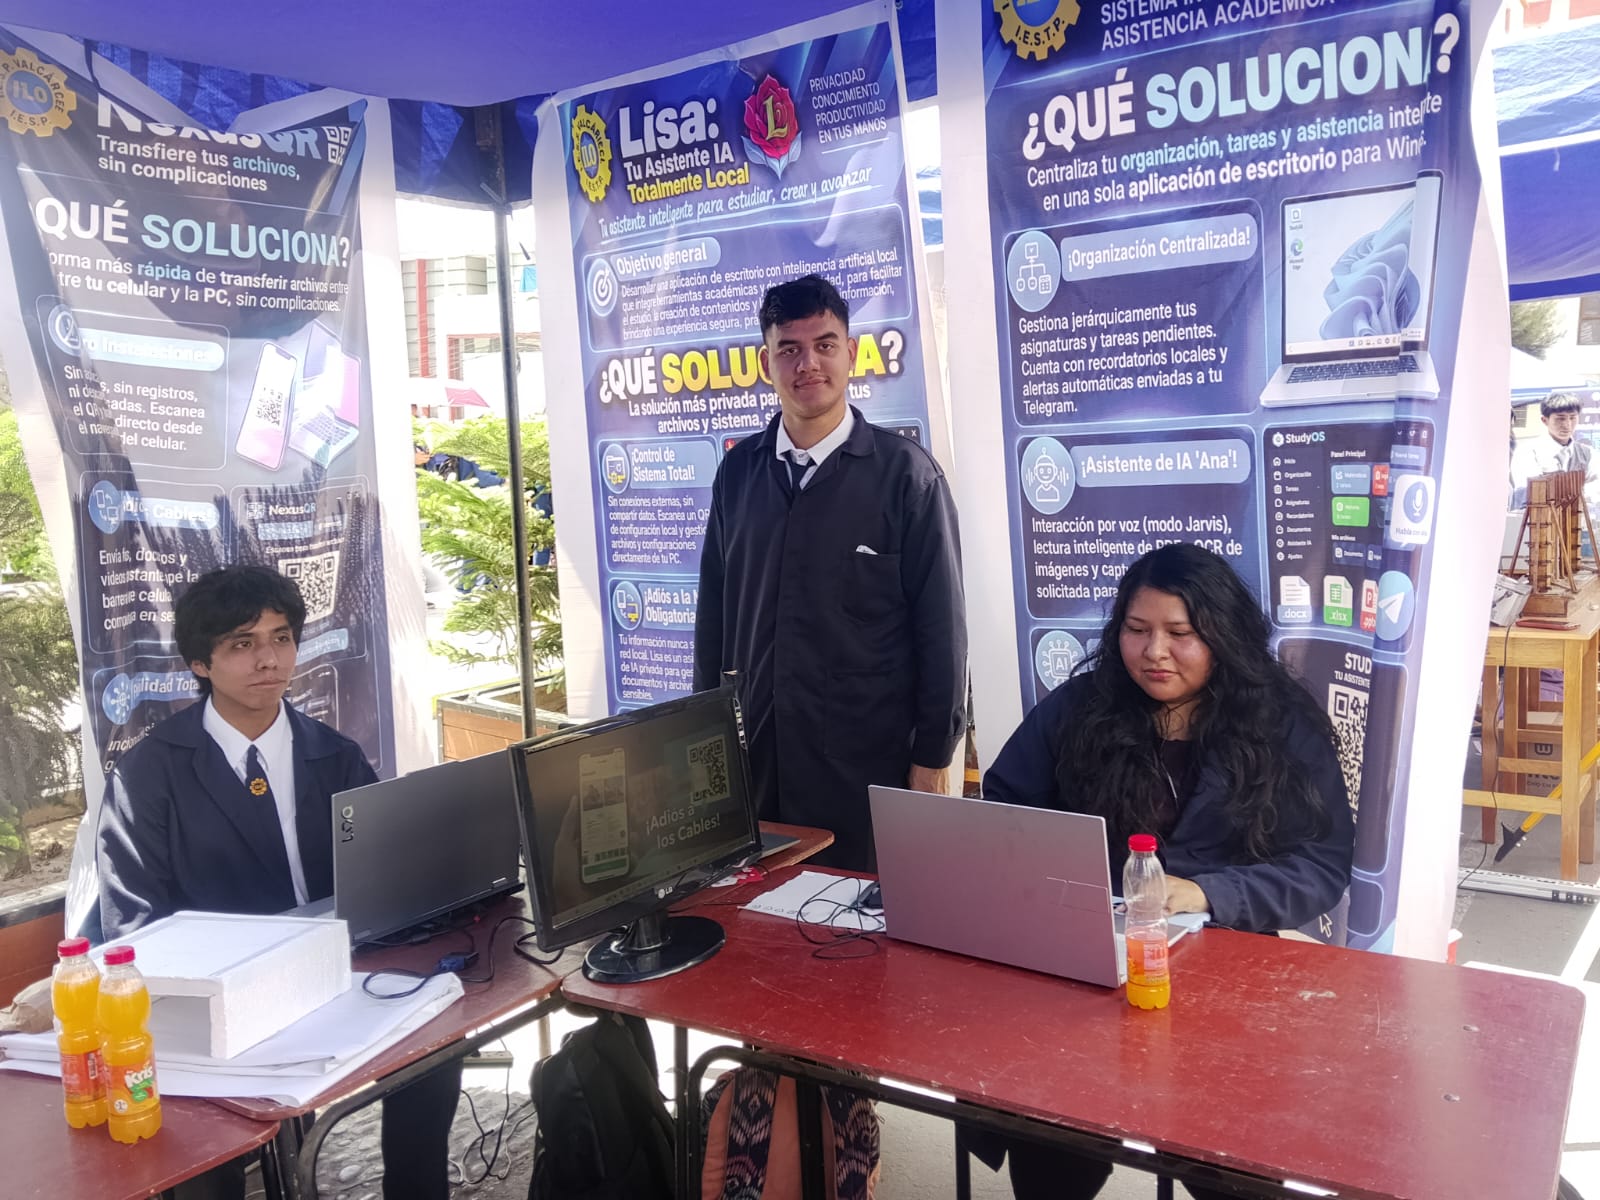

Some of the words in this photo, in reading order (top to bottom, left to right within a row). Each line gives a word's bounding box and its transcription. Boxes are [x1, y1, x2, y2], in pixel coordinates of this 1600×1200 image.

[1100, 0, 1177, 24] SISTEMA
[1015, 17, 1065, 46] I.E.S.T.P.
[1102, 8, 1208, 50] ASISTENCIA
[809, 67, 866, 93] PRIVACIDAD
[812, 82, 880, 109] CONOCIMIENTO
[815, 99, 886, 127] PRODUCTIVIDAD
[1021, 66, 1136, 161] ¿QUÉ
[619, 97, 719, 159] Lisa:
[819, 128, 832, 144] EN
[832, 126, 852, 141] TUS
[854, 119, 887, 136] MANOS
[97, 135, 197, 164] Transfiere
[201, 145, 229, 167] tus
[232, 153, 300, 181] archivos,
[623, 161, 642, 182] Tu
[645, 149, 710, 178] Asistente
[715, 142, 734, 164] IA
[1027, 157, 1098, 188] Centraliza
[1101, 155, 1118, 174] tu
[1121, 135, 1224, 173] organización,
[1227, 130, 1278, 154] tareas
[1281, 129, 1292, 150] y
[1296, 109, 1384, 145] asistencia
[98, 156, 126, 173] sin
[131, 161, 268, 192] complicaciones
[627, 172, 703, 205] Totalmente
[706, 162, 749, 187] Local
[1043, 193, 1060, 211] en
[1064, 188, 1090, 208] una
[1093, 180, 1125, 203] sola
[1128, 167, 1217, 198] aplicación
[1219, 164, 1242, 186] de
[1246, 150, 1337, 181] escritorio
[1340, 147, 1382, 173] para
[599, 217, 608, 237] Tu
[609, 210, 646, 235] asistente
[648, 201, 694, 230] inteligente
[697, 198, 723, 223] para
[728, 188, 775, 211] estudiar,
[781, 183, 808, 203] crear
[811, 183, 817, 202] y
[821, 165, 872, 194] avanzar
[141, 214, 350, 268] SOLUCIONA?
[1067, 239, 1156, 272] ¡Organización
[1159, 226, 1250, 256] Centralizada!
[616, 253, 662, 276] Objetivo
[663, 243, 707, 270] general
[711, 270, 722, 283] de
[724, 265, 764, 284] escritorio
[765, 265, 780, 279] con
[782, 257, 836, 277] inteligencia
[838, 250, 876, 272] artificial
[877, 247, 898, 264] local
[96, 257, 132, 275] más
[138, 260, 191, 282] rápida
[195, 267, 216, 284] de
[220, 270, 288, 290] transferir
[290, 278, 329, 293] archivos
[847, 269, 867, 287] para
[869, 265, 903, 283] facilitar
[85, 276, 102, 292] tu
[106, 277, 166, 299] celular
[170, 287, 181, 302] y
[185, 285, 198, 302] la
[203, 289, 232, 308] PC,
[236, 290, 257, 306] sin
[260, 293, 341, 312] complicaciones.
[690, 304, 699, 316] de
[702, 300, 750, 315] contenidos
[1019, 314, 1069, 334] Gestiona
[1071, 303, 1173, 333] jerárquicamente
[1175, 302, 1197, 317] tus
[1020, 337, 1087, 357] asignaturas
[1090, 338, 1097, 352] y
[1100, 330, 1140, 348] tareas
[1143, 323, 1217, 347] pendientes.
[1021, 359, 1060, 376] Cuenta
[1063, 359, 1085, 372] con
[1088, 350, 1168, 369] recordatorios
[1171, 345, 1216, 364] locales
[1219, 347, 1227, 363] y
[599, 349, 657, 403] ¿QUÉ
[1023, 381, 1059, 397] alertas
[1062, 374, 1134, 393] automáticas
[1137, 369, 1193, 388] enviadas
[1197, 371, 1205, 384] a
[1207, 368, 1223, 383] tu
[114, 382, 133, 394] sin
[136, 384, 198, 402] registros,
[629, 400, 640, 416] La
[641, 396, 681, 415] solución
[682, 397, 707, 412] más
[709, 391, 757, 412] privada
[849, 383, 871, 400] tus
[150, 403, 205, 418] Escanea
[1023, 399, 1078, 416] Telegram.
[115, 414, 160, 431] directo
[163, 419, 203, 435] desde
[658, 416, 700, 433] archivos
[701, 418, 709, 434] y
[711, 414, 763, 430] sistema,
[1286, 431, 1326, 444] StudyOS
[141, 435, 187, 450] celular.
[632, 447, 662, 465] ¡Control
[664, 447, 675, 461] de
[633, 467, 666, 481] Sistema
[668, 465, 695, 480] Total!
[1081, 455, 1153, 478] ¡Asistente
[1155, 453, 1173, 471] de
[1176, 452, 1193, 470] IA
[1195, 450, 1238, 469] 'Ana'!
[269, 502, 316, 515] NexusQR
[1032, 516, 1094, 533] Interacción
[1098, 520, 1116, 535] por
[1119, 519, 1140, 532] voz
[1143, 516, 1182, 535] (modo
[1186, 515, 1232, 534] Jarvis),
[1033, 539, 1071, 554] lectura
[1073, 540, 1135, 557] inteligente
[1138, 539, 1153, 553] de
[1226, 539, 1242, 555] de
[1035, 562, 1089, 580] imágenes
[1091, 563, 1098, 579] y
[644, 588, 671, 605] ¡Adiós
[1036, 584, 1090, 599] solicitada
[1282, 609, 1307, 618] .docx
[1329, 611, 1348, 622] .xlsx
[1055, 657, 1068, 670] AI
[1345, 652, 1372, 674] STUD
[1334, 670, 1343, 680] TU
[1344, 674, 1370, 688] ASISTENTE
[645, 807, 685, 835] ¡Adiós
[688, 805, 695, 817] a
[657, 835, 675, 849] los
[678, 813, 721, 841] Cables!
[665, 886, 673, 894] LG
